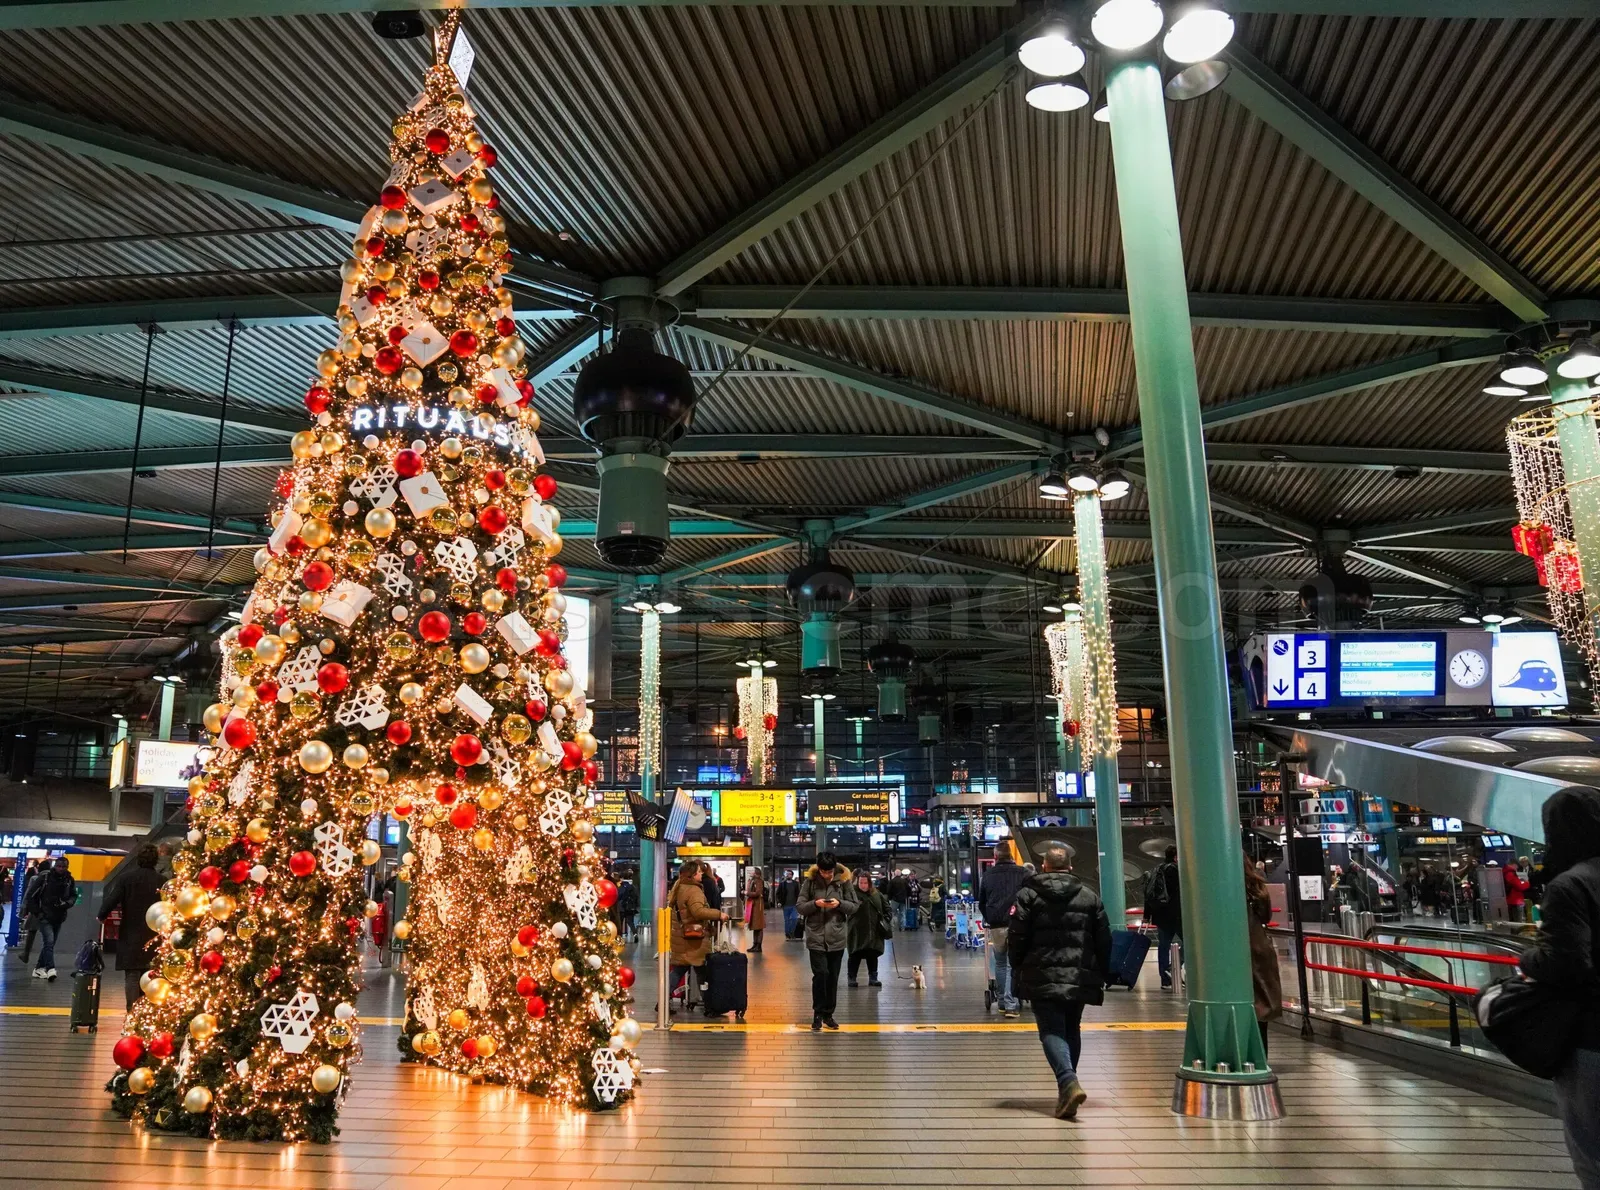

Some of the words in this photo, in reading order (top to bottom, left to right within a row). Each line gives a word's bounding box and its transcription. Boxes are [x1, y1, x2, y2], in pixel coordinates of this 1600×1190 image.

[353, 407, 510, 446] RITUALS
[1307, 650, 1317, 666] 3
[1307, 682, 1317, 697] 4
[760, 793, 774, 801] 3-4
[770, 804, 775, 813] 3
[751, 815, 775, 824] 17-32
